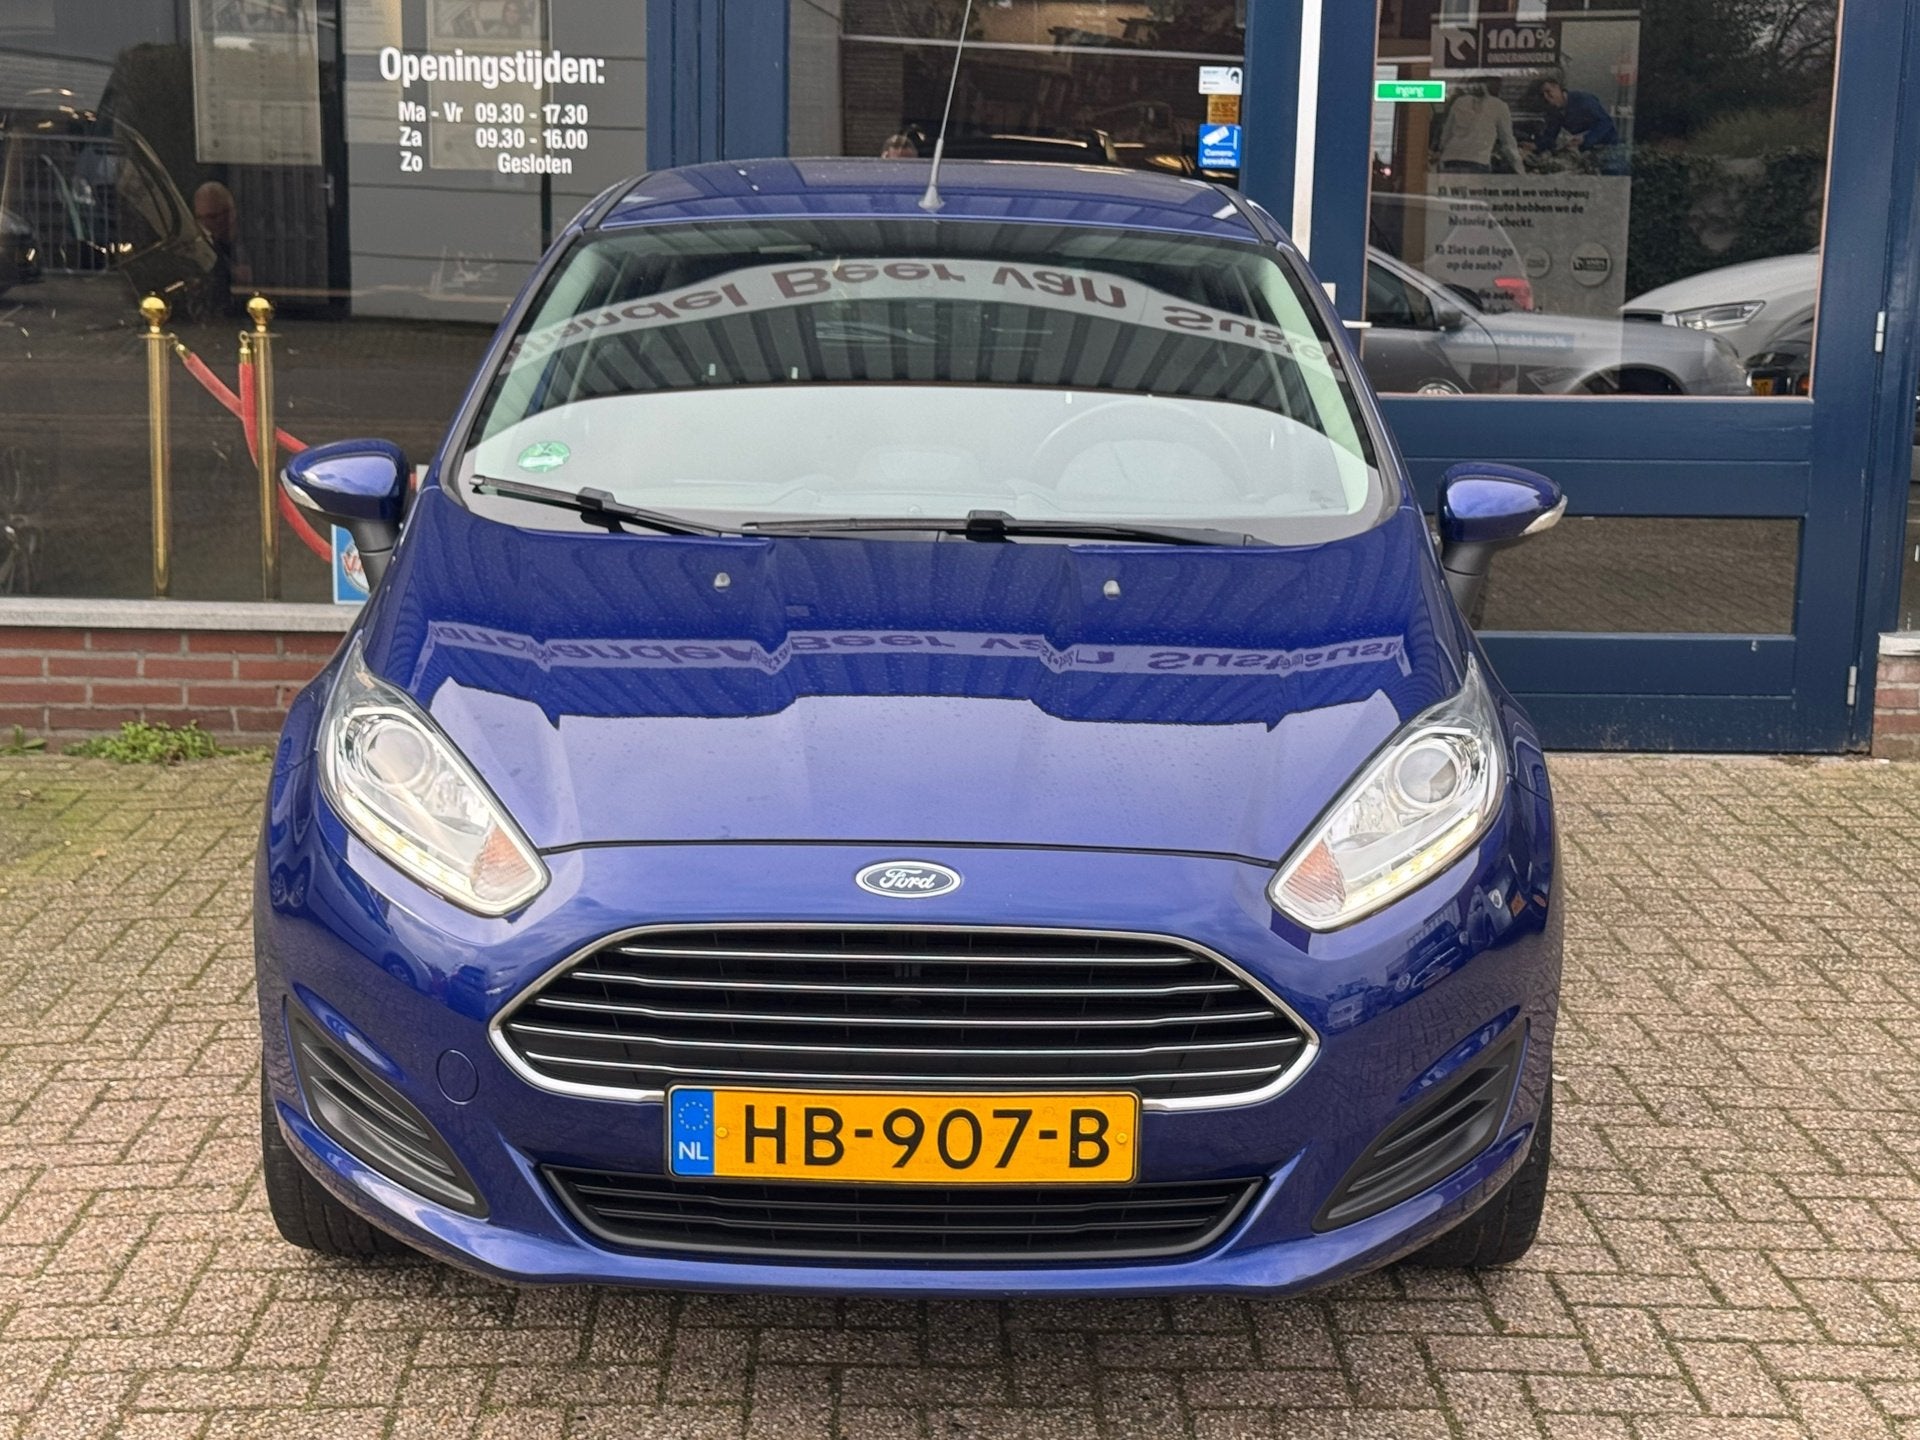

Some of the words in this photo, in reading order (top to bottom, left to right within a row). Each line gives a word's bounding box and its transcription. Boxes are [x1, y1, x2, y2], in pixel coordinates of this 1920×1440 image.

[1486, 28, 1556, 50] 100%
[380, 47, 605, 89] Openingstijden:
[398, 101, 426, 122] Ma
[443, 102, 463, 122] Vr
[475, 103, 525, 124] 09.30
[542, 104, 588, 125] 17.30
[400, 127, 422, 147] Za
[475, 128, 525, 149] 09.30
[542, 129, 588, 150] 16.00
[400, 151, 423, 172] Zo
[498, 153, 572, 174] Gesloten
[879, 868, 937, 888] Ford
[744, 1104, 1110, 1170] HB-907-B
[678, 1141, 709, 1161] NL
